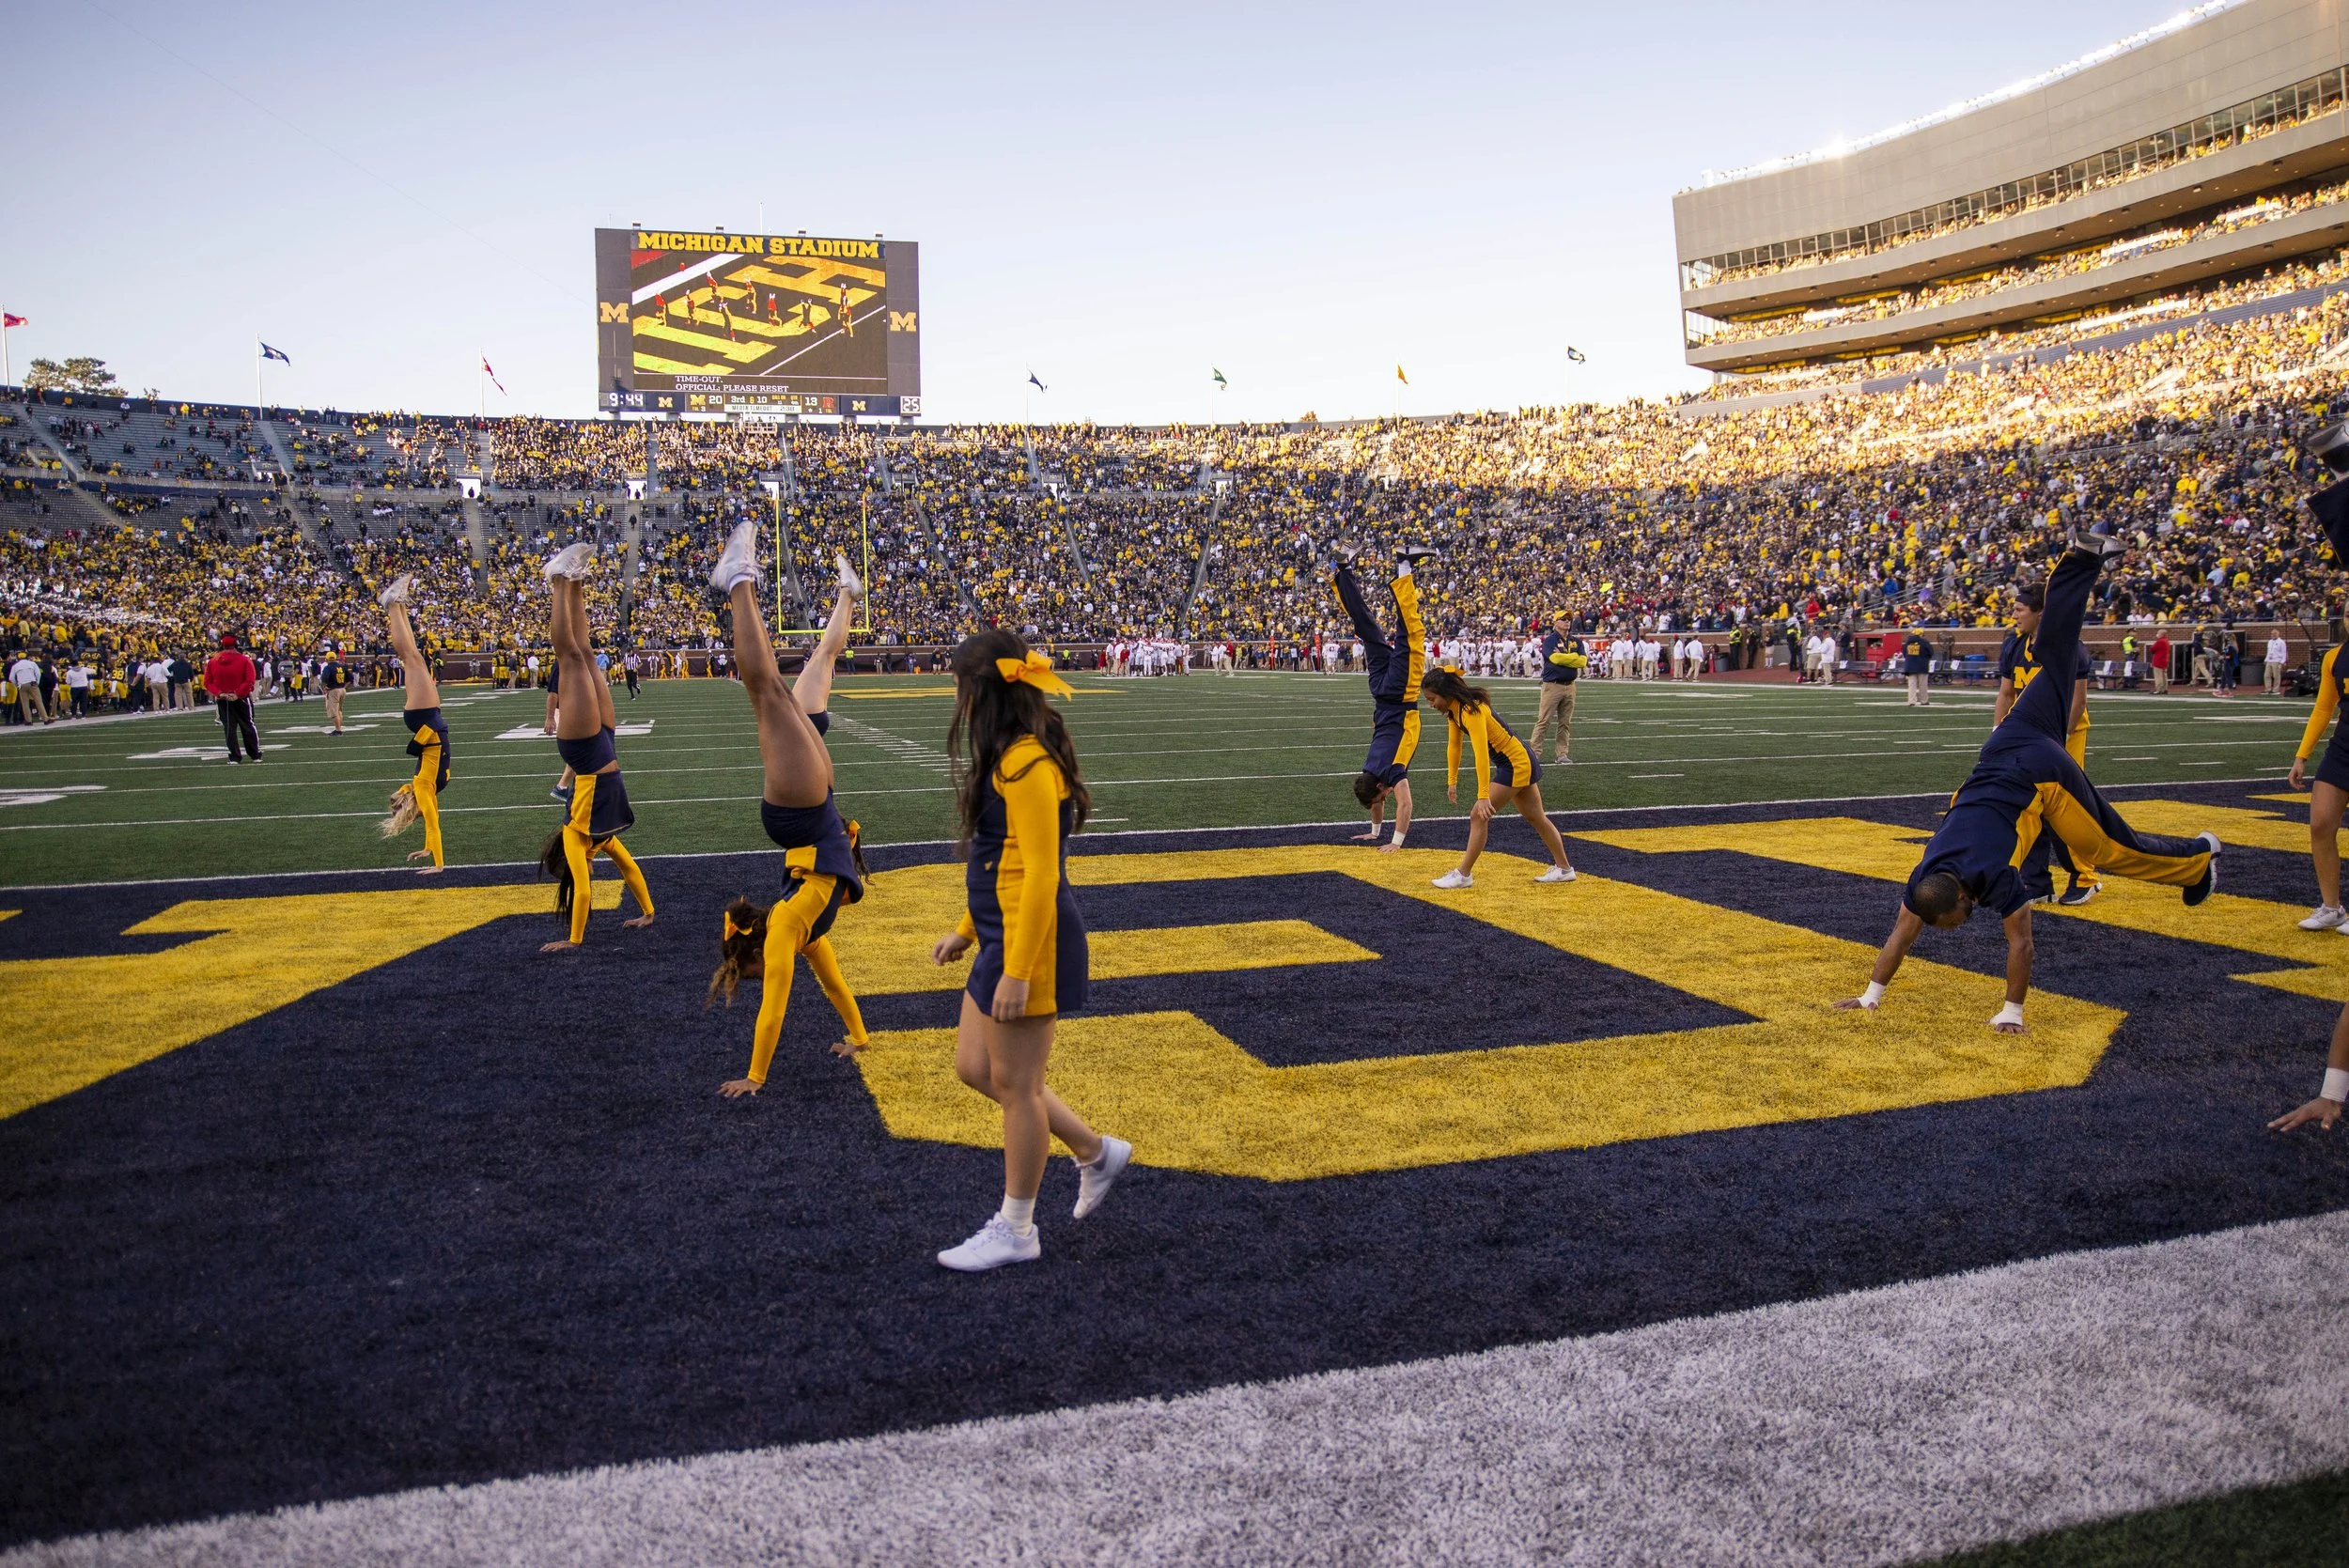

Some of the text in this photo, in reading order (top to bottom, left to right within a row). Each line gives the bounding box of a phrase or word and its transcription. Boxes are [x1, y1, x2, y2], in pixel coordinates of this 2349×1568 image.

[638, 232, 879, 258] MICHIGAN STADIUM
[600, 302, 629, 323] M
[890, 311, 917, 332] M
[609, 393, 644, 407] 9:44
[658, 396, 673, 408] M
[690, 395, 723, 405] M 20
[731, 396, 745, 404] 3rd
[757, 396, 768, 404] 10
[823, 397, 834, 408] R
[852, 400, 866, 411] M
[903, 397, 920, 411] 25
